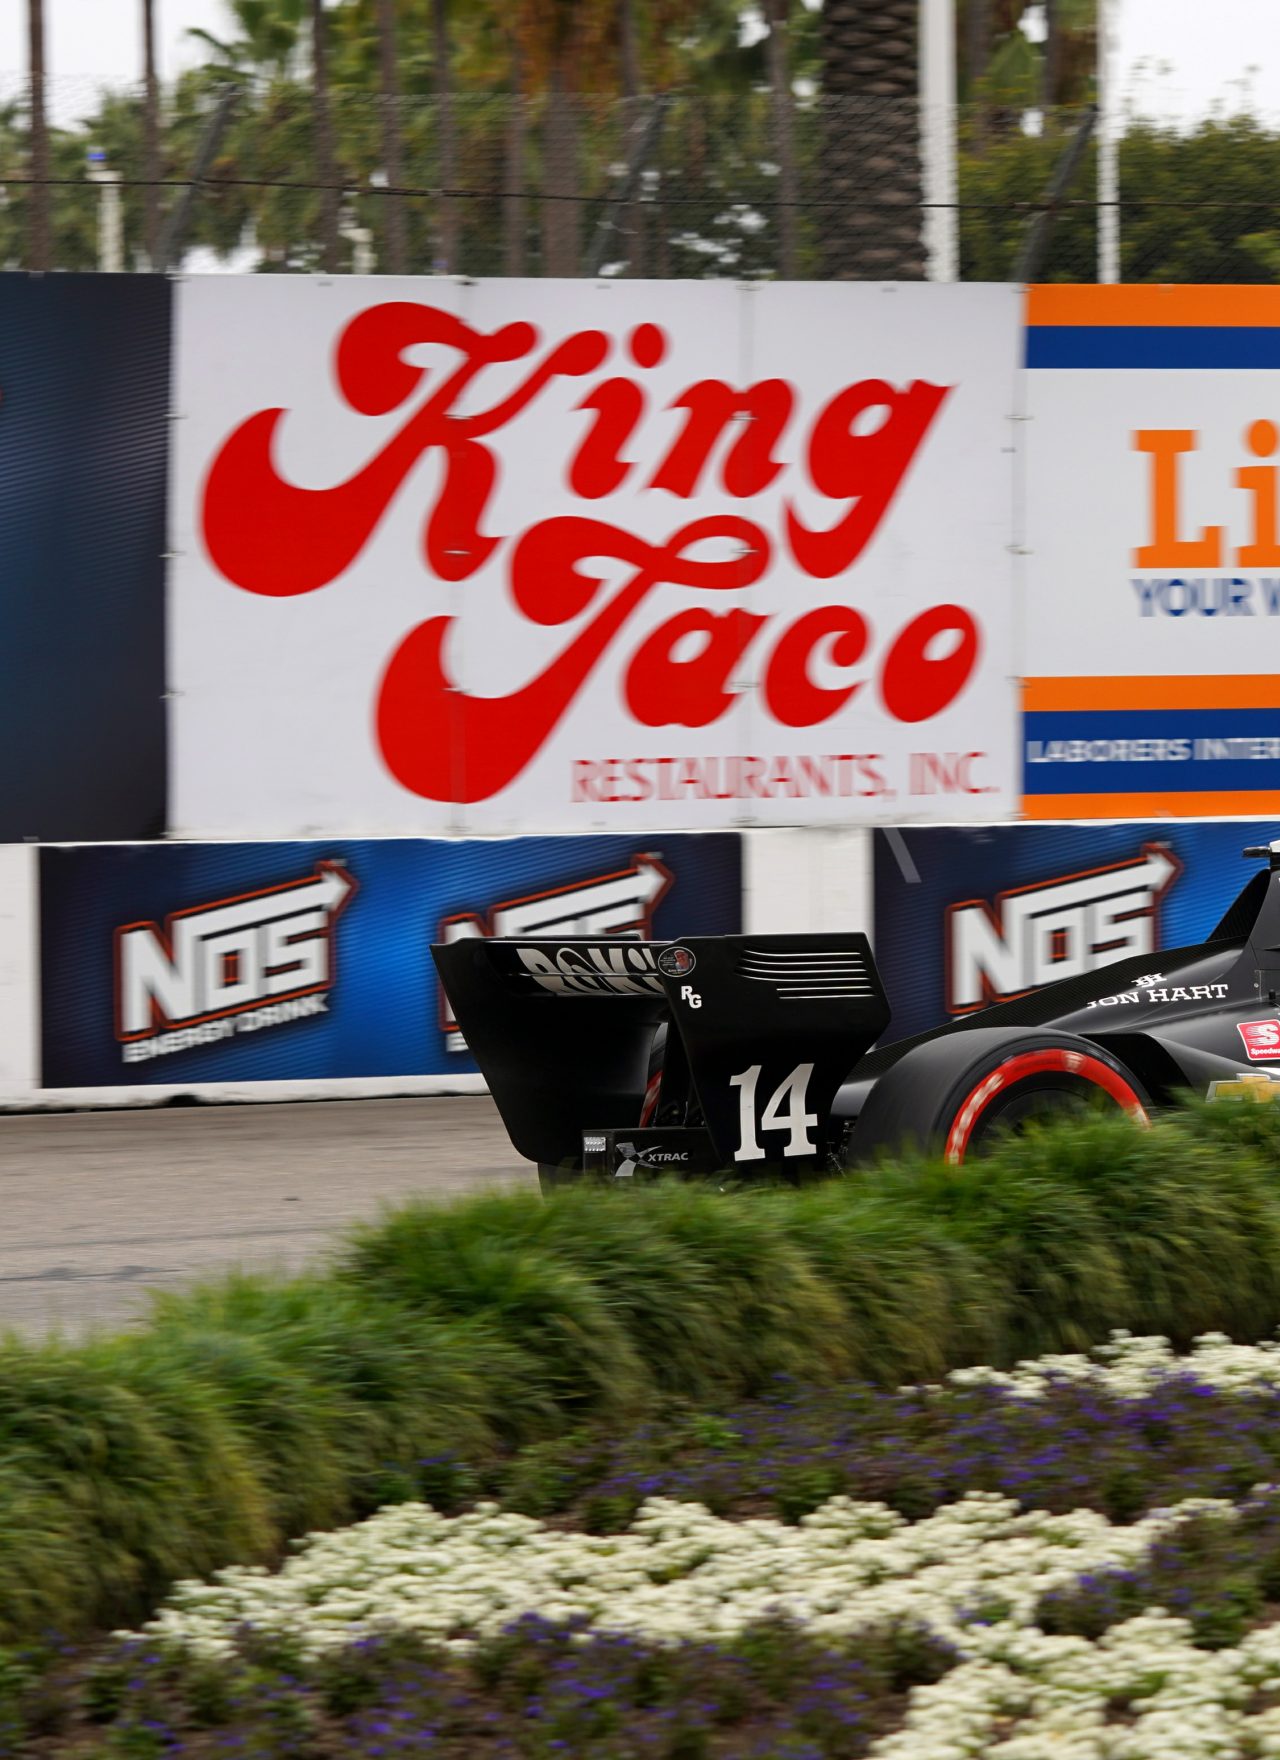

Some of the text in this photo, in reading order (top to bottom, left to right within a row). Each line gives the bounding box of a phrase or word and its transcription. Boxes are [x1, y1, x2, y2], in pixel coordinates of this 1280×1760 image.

[199, 301, 958, 598] King
[1132, 577, 1252, 618] YOUR
[374, 514, 982, 804] Taco
[570, 751, 1000, 803] RESTAURANTS, INC.
[1026, 738, 1192, 763] LABORERS
[116, 864, 358, 1040] NOS
[946, 844, 1184, 1013] NOS
[1086, 984, 1228, 1009] JON HART
[730, 1063, 818, 1162] 14
[647, 1152, 689, 1162] XTRAC
